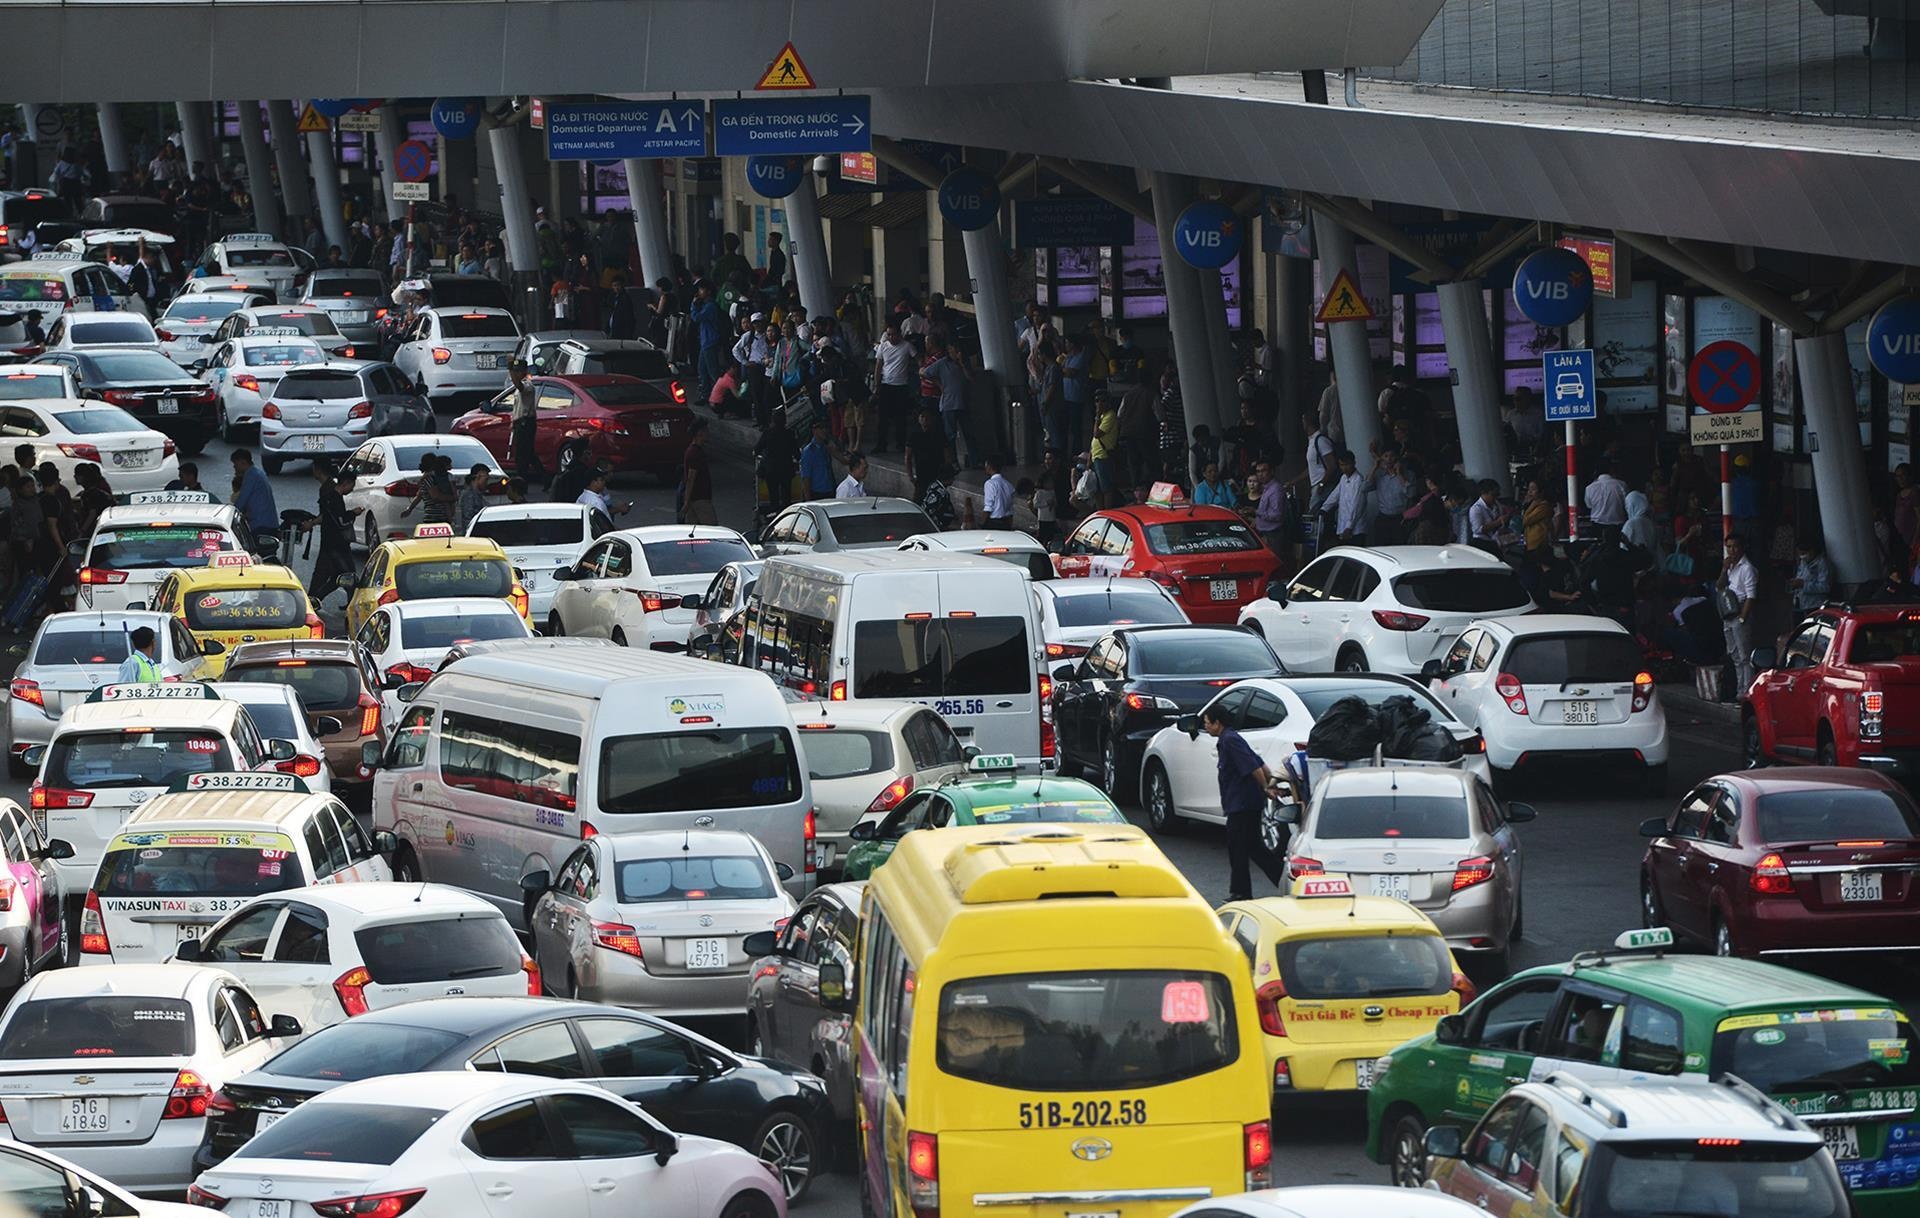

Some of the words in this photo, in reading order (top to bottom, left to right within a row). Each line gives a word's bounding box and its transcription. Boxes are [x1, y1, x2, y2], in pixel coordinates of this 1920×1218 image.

[439, 111, 466, 124] VIB
[552, 113, 567, 122] GA
[583, 112, 618, 121] TRONG
[655, 108, 677, 133] A
[721, 116, 739, 127] GA
[766, 114, 805, 125] TRONG
[552, 125, 595, 134] Domestic
[597, 124, 647, 135] Departures
[749, 129, 797, 140] Domestic
[799, 128, 839, 138] Arrivals
[553, 141, 584, 150] VIETNAM
[584, 141, 616, 149] AIRLINES
[643, 140, 674, 148] JETSTAR
[675, 139, 701, 147] PACIFIC
[754, 164, 785, 180] VIB
[947, 194, 981, 210] VIB
[1184, 230, 1221, 247] VIB
[1526, 279, 1569, 300] VIB
[1574, 355, 1582, 366] A
[1551, 406, 1558, 415] XE
[1732, 416, 1742, 426] XE
[1693, 429, 1719, 441] KHÔNG
[1719, 428, 1735, 440] QUÁ
[1735, 431, 1740, 439] 3
[1741, 426, 1760, 438] PHÚT
[180, 494, 192, 502] 27
[194, 494, 207, 502] 27
[220, 556, 248, 565] TAXI
[228, 606, 240, 617] 36
[242, 606, 254, 617] 36
[256, 606, 268, 617] 36
[269, 606, 281, 617] 36
[126, 688, 162, 698] 38.27
[166, 687, 182, 697] 27
[184, 687, 200, 697] 27
[1570, 702, 1589, 712] 51G
[188, 739, 216, 750] 10484
[982, 757, 1008, 766] TAXI
[212, 776, 249, 787] 38.27
[254, 776, 270, 787] 27
[275, 776, 292, 787] 27
[220, 836, 251, 846] 15.5%
[1379, 876, 1400, 888] 51F
[1851, 873, 1872, 887] 51F
[1307, 881, 1345, 893] TAXI
[210, 900, 248, 912] 38.2
[1635, 932, 1664, 944] TAXI
[696, 940, 718, 953] 51G
[1288, 1010, 1314, 1022] Taxi
[1388, 1006, 1422, 1018] Cheap
[1425, 1005, 1449, 1016] Taxi
[1869, 1090, 1884, 1108] 38
[1887, 1090, 1901, 1108] 38
[1904, 1090, 1918, 1108] 38
[72, 1099, 98, 1114] 51G
[1019, 1099, 1147, 1129] 51B-202.58
[1824, 1127, 1848, 1142] 68A
[259, 1202, 280, 1218] 60A
